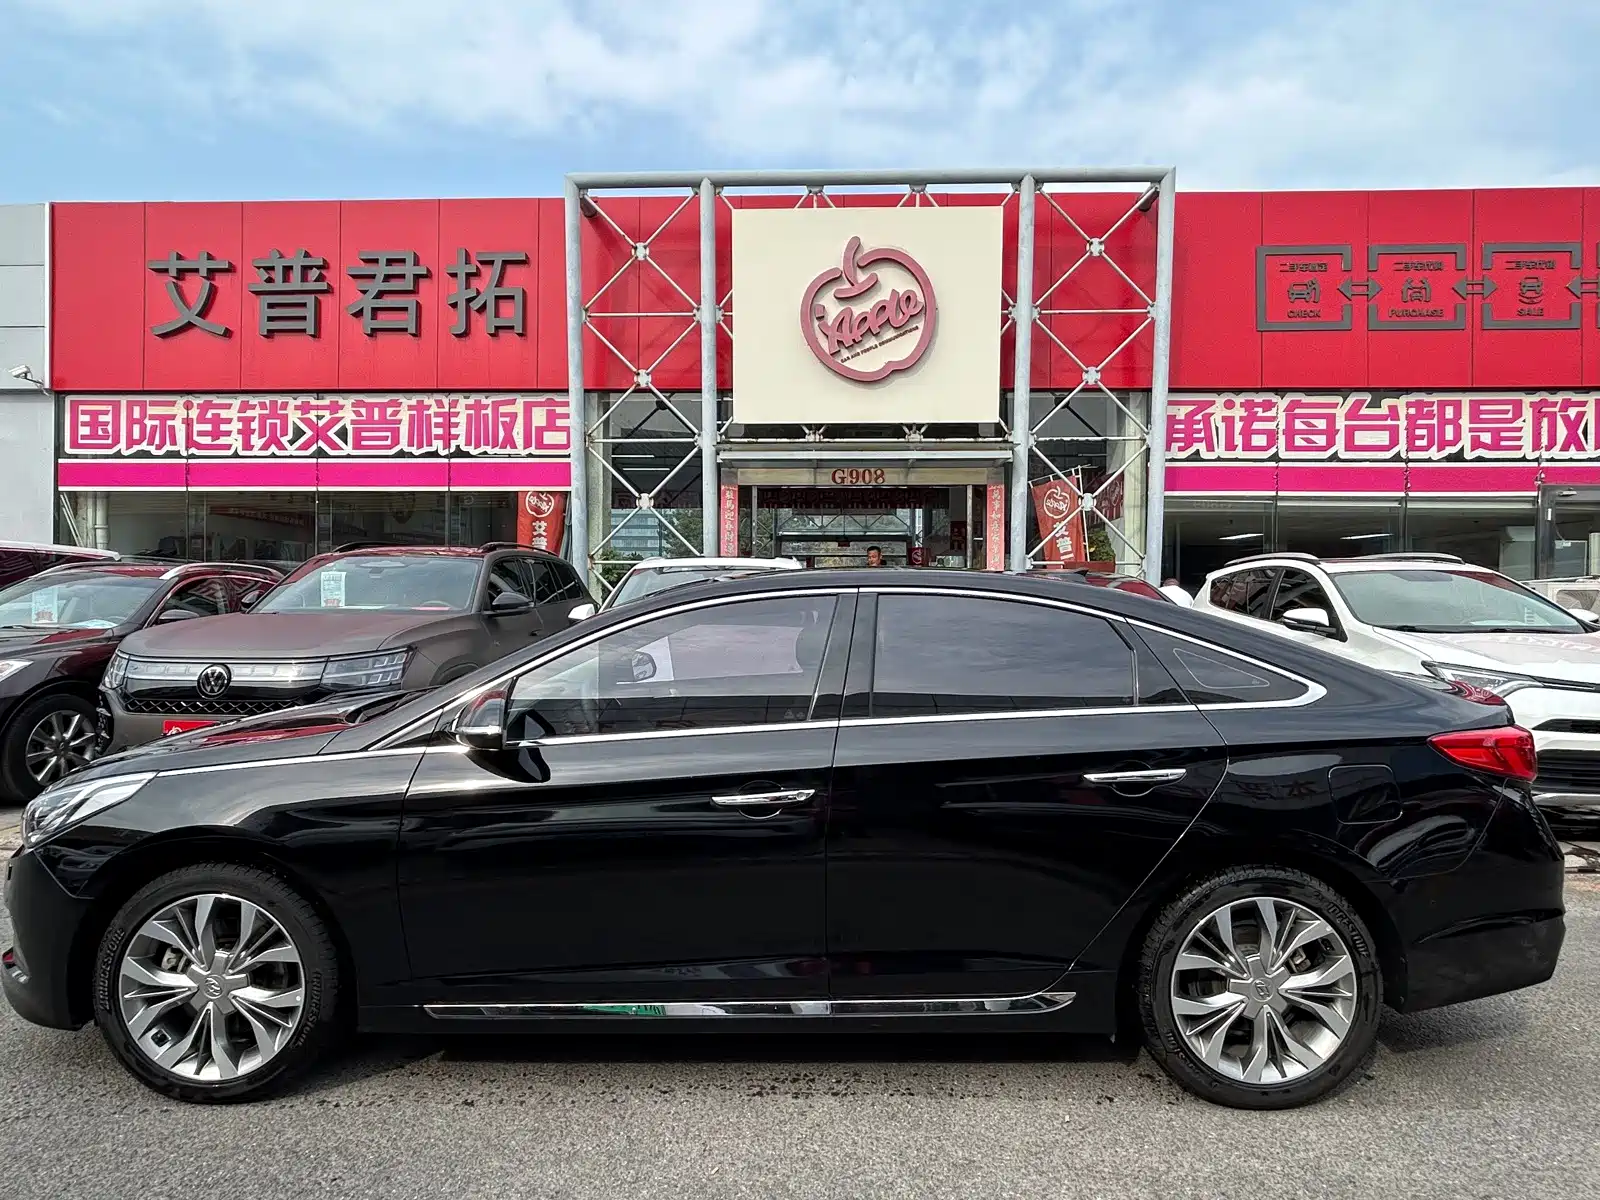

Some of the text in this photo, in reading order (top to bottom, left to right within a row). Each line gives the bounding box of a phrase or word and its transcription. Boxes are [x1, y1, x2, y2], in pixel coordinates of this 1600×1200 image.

[148, 247, 529, 339] 艾普君拓
[1287, 309, 1321, 319] CHECK
[1388, 308, 1444, 318] PURCHASE
[1517, 308, 1545, 317] SALE
[68, 397, 571, 453] 国际连锁艾普样板店
[1166, 397, 1600, 453] 承诺每台都是放
[831, 467, 886, 485] G908
